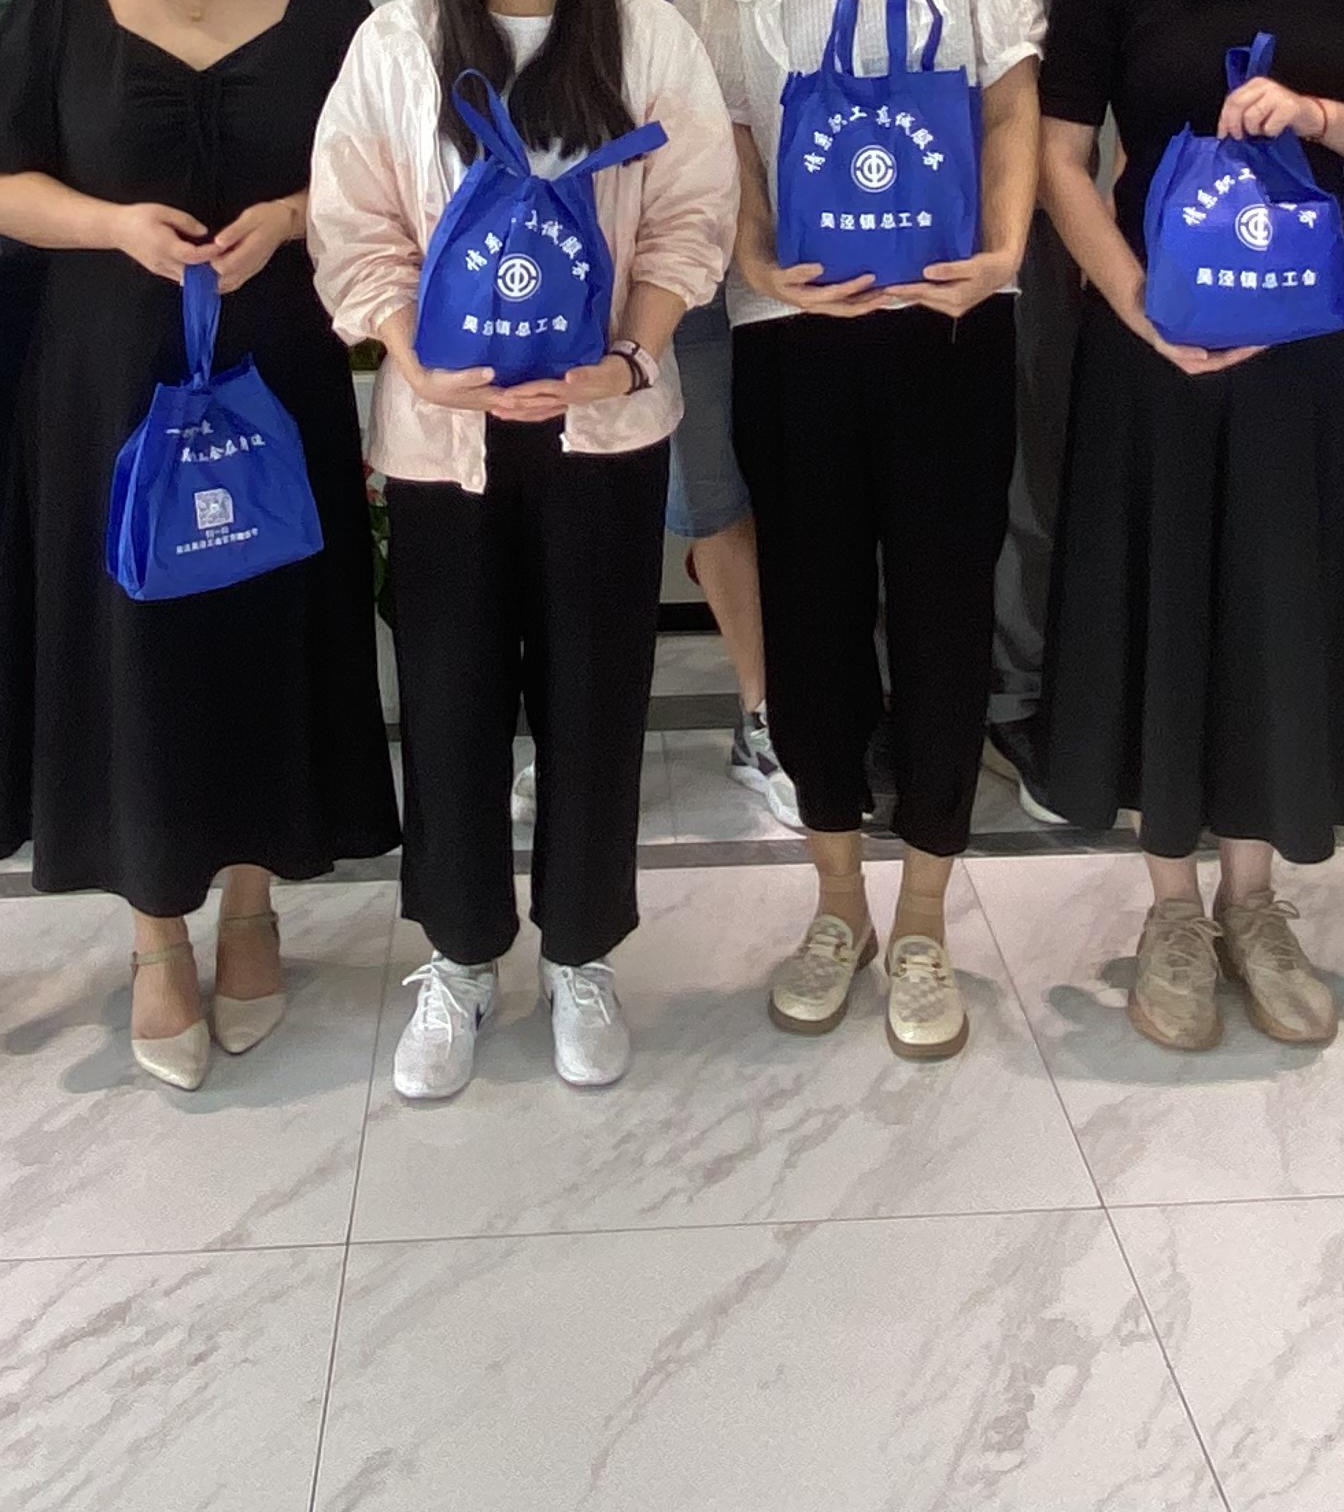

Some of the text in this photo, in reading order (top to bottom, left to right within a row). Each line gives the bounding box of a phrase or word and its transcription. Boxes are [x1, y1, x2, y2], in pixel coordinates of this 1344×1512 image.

[819, 210, 934, 231] 吴泾镇总工会
[1196, 267, 1317, 290] 吴泾镇总工会
